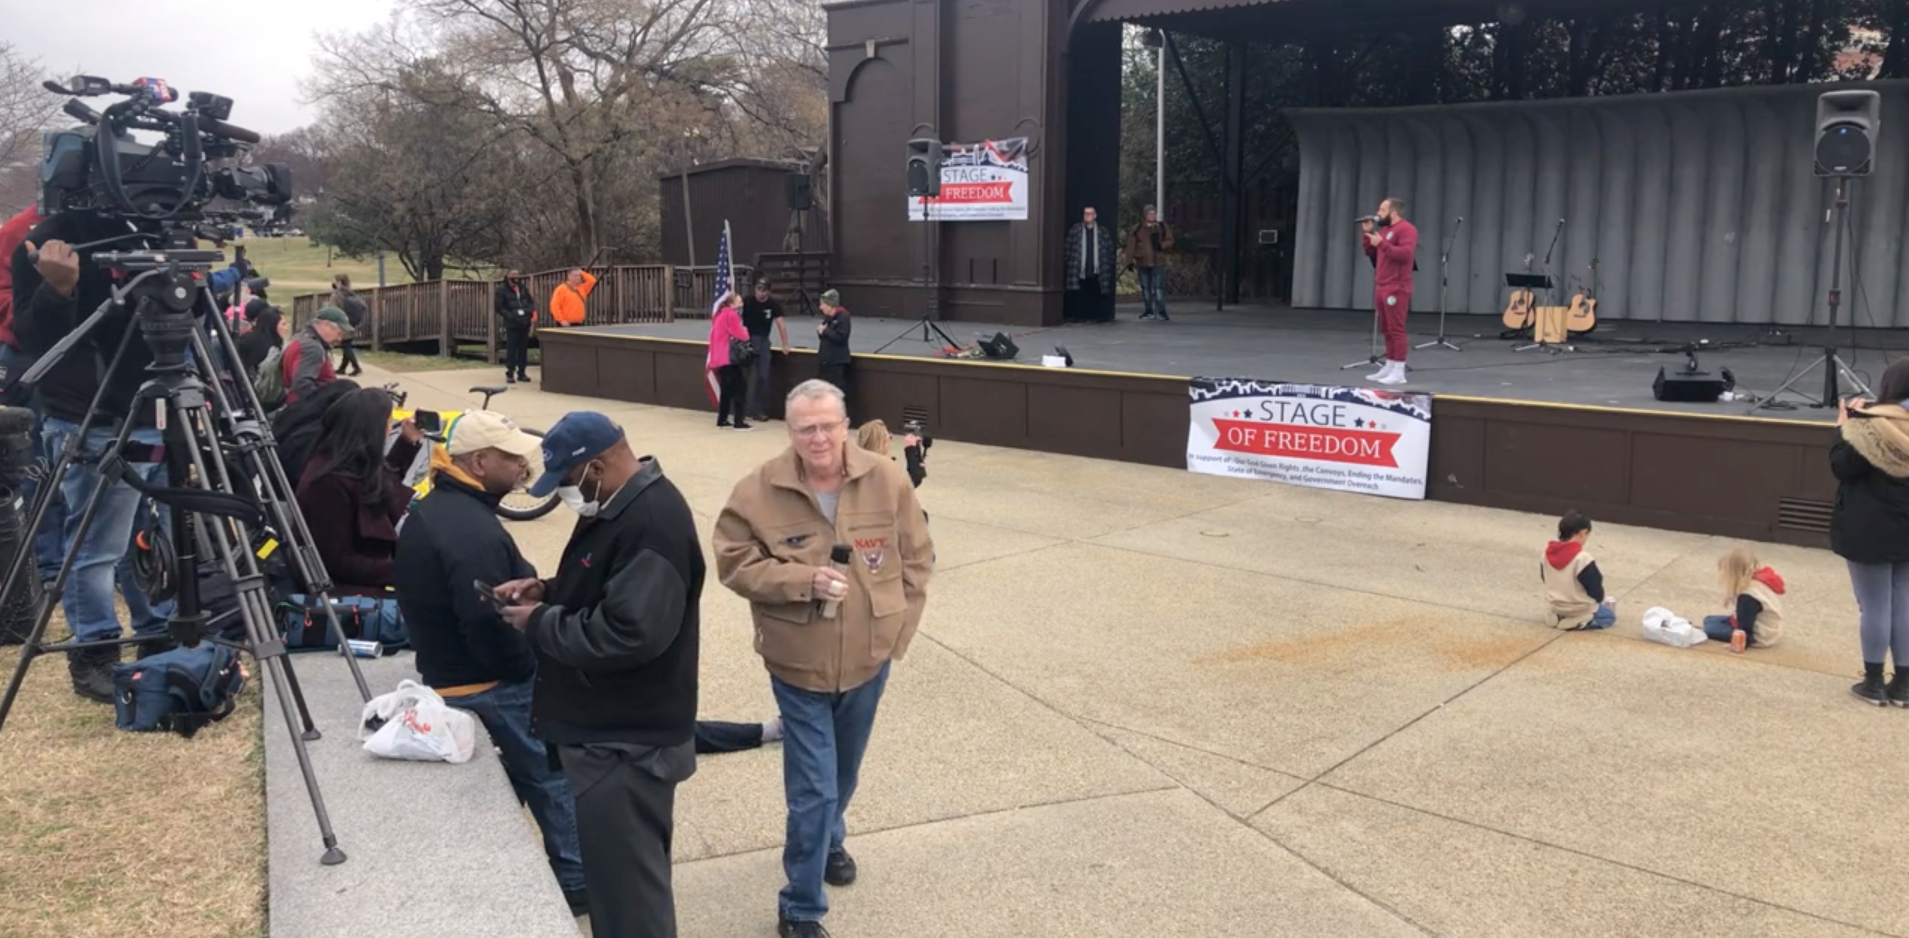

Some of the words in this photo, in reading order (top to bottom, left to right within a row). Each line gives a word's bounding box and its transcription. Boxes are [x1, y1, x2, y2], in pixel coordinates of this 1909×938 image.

[943, 168, 987, 182] STAGE
[945, 187, 1004, 199] FREEDOM
[1260, 399, 1347, 427] STAGE
[1227, 426, 1257, 447] OF
[1263, 429, 1382, 459] FREEDOM
[1196, 454, 1222, 463] support
[1279, 463, 1300, 473] Rights
[1316, 466, 1347, 477] Convoys,
[1348, 469, 1373, 480] Ending
[1373, 472, 1385, 480] the
[1227, 466, 1245, 474] State
[1302, 475, 1346, 486] Government
